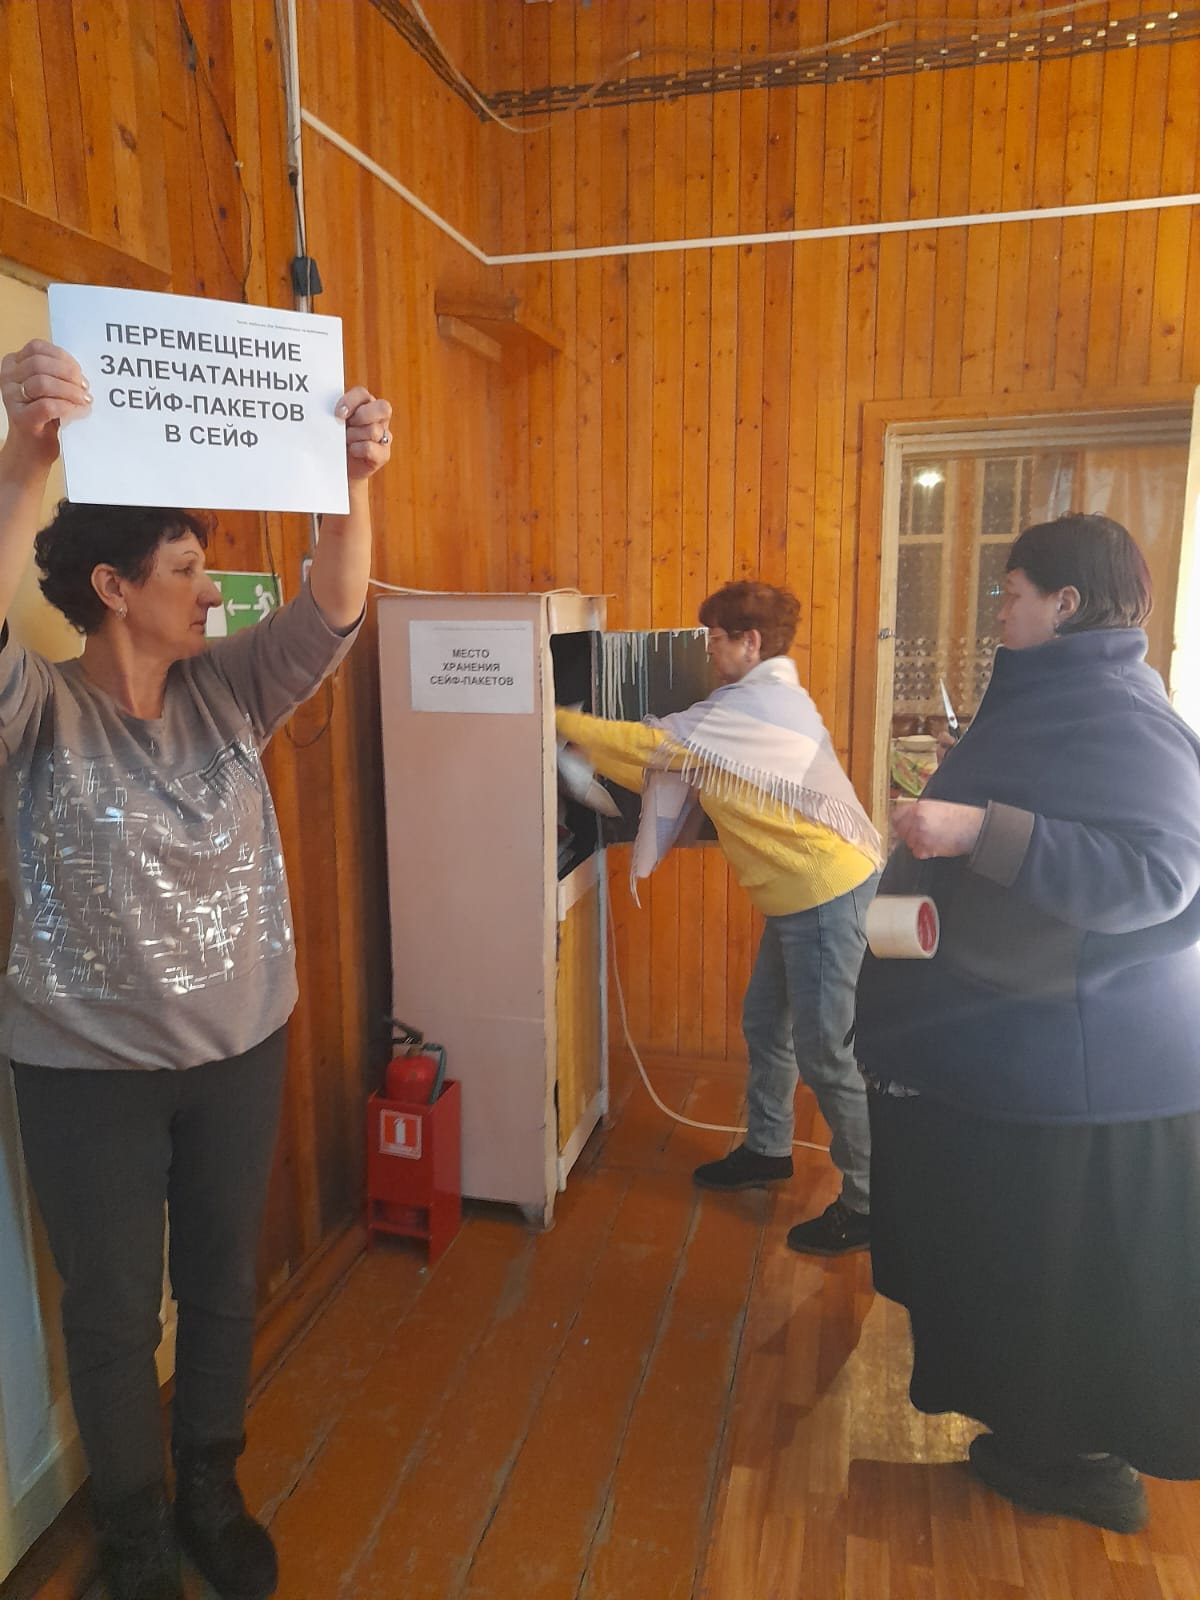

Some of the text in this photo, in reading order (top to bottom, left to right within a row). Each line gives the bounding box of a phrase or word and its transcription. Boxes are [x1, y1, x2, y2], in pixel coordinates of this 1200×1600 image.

[105, 322, 303, 363] ПЕРЕМЕЩЕНИЕ
[100, 354, 311, 394] ЗАПЕЧАТАННЫХ
[108, 385, 305, 422] СЕЙФ-ПАКЕТОВ
[164, 423, 259, 449] В СЕЙФ
[452, 648, 490, 659] МЕСТО
[430, 674, 514, 686] СЕЙФ-ПАКЕТОВ
[442, 662, 501, 672] ХРАНЕНИЯ
